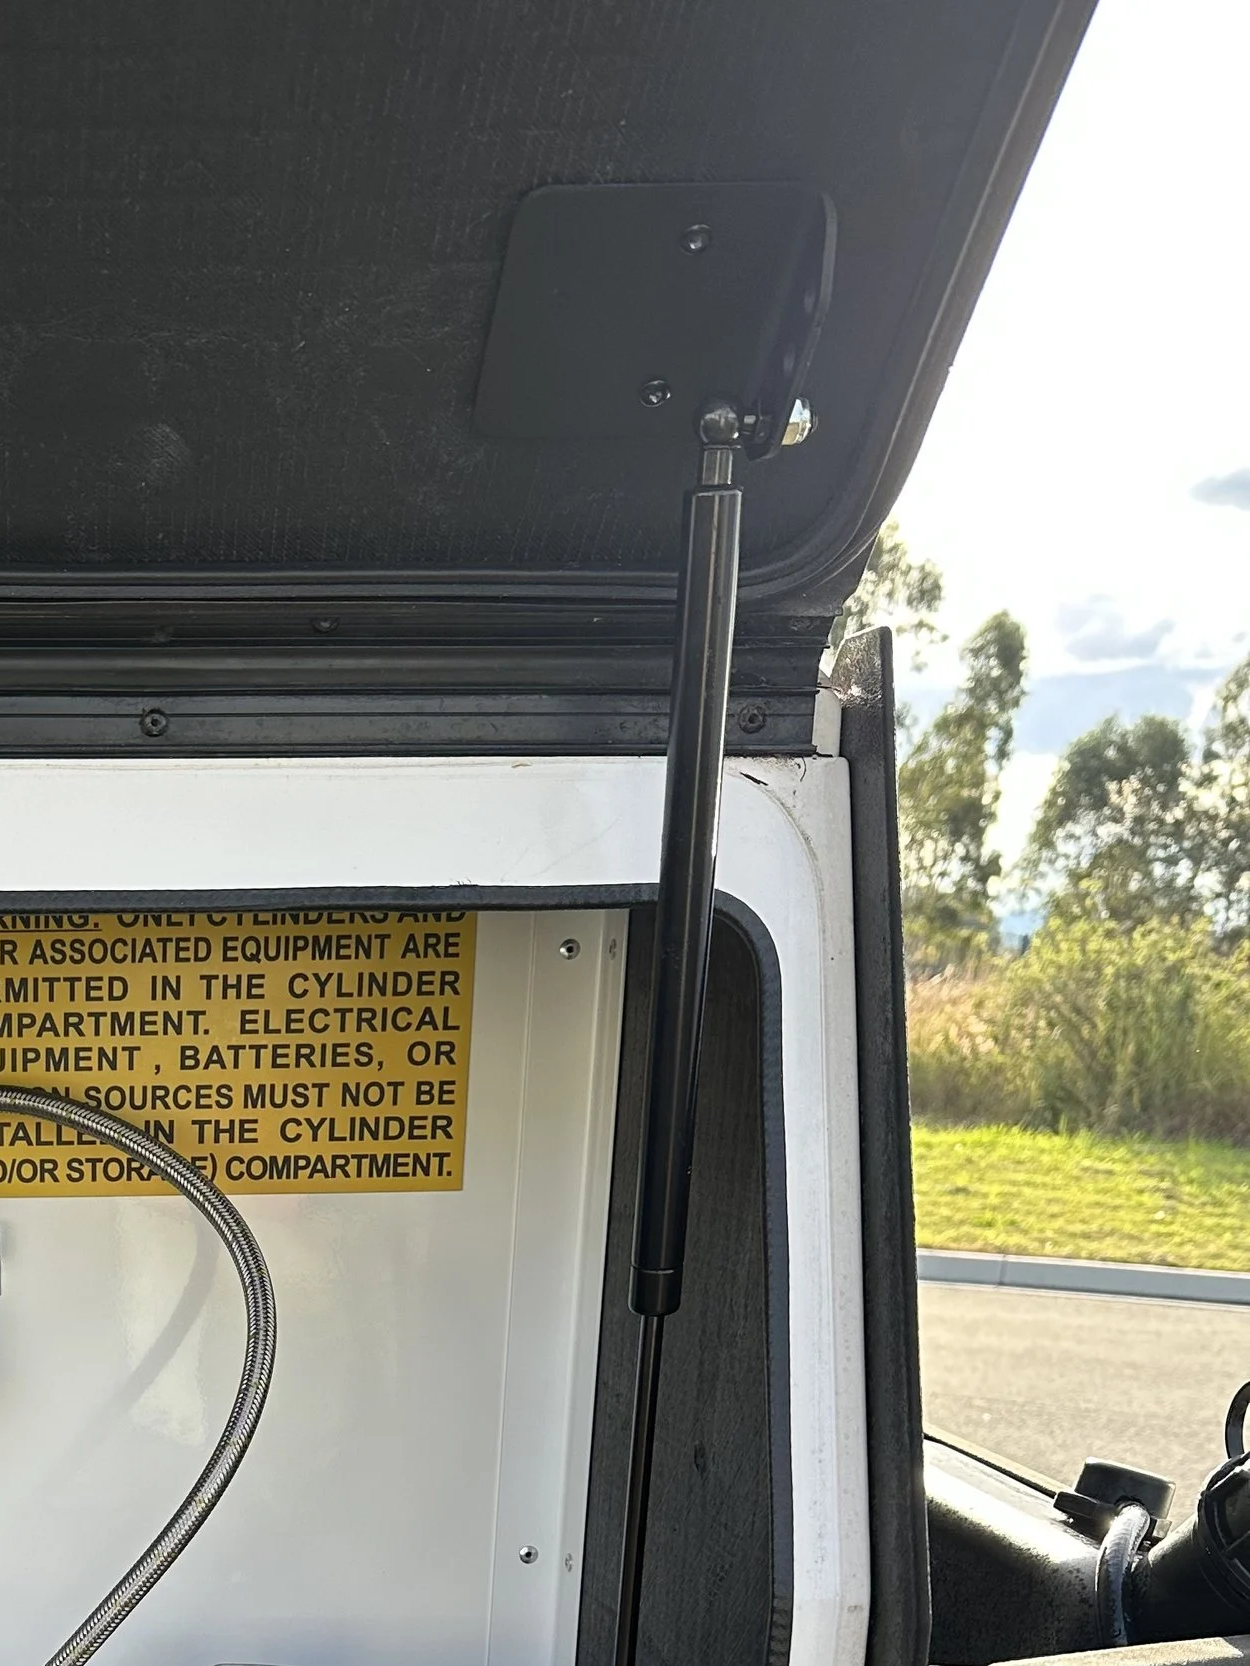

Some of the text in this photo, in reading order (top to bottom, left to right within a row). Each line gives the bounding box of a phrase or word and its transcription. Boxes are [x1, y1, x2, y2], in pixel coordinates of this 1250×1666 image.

[29, 937, 211, 965] ASSOCIATED
[222, 934, 391, 964] EQUIPMENT
[400, 933, 460, 959] ARE
[151, 975, 181, 1001] IN
[200, 974, 265, 1000] THE
[288, 970, 460, 999] CYLINDER
[240, 1006, 460, 1034] ELECTRICAL
[180, 1042, 384, 1071] BATTERIES,
[407, 1041, 457, 1066] OR
[84, 1084, 233, 1110] SOURCES
[243, 1083, 330, 1109] MUST
[341, 1081, 405, 1108] NOT
[415, 1080, 456, 1106] BE
[144, 1120, 175, 1145] IN
[192, 1119, 259, 1144] THE
[280, 1115, 453, 1143] CYLINDER
[66, 1153, 217, 1182] STORAE)
[225, 1152, 452, 1181] COMPARTMENT.
